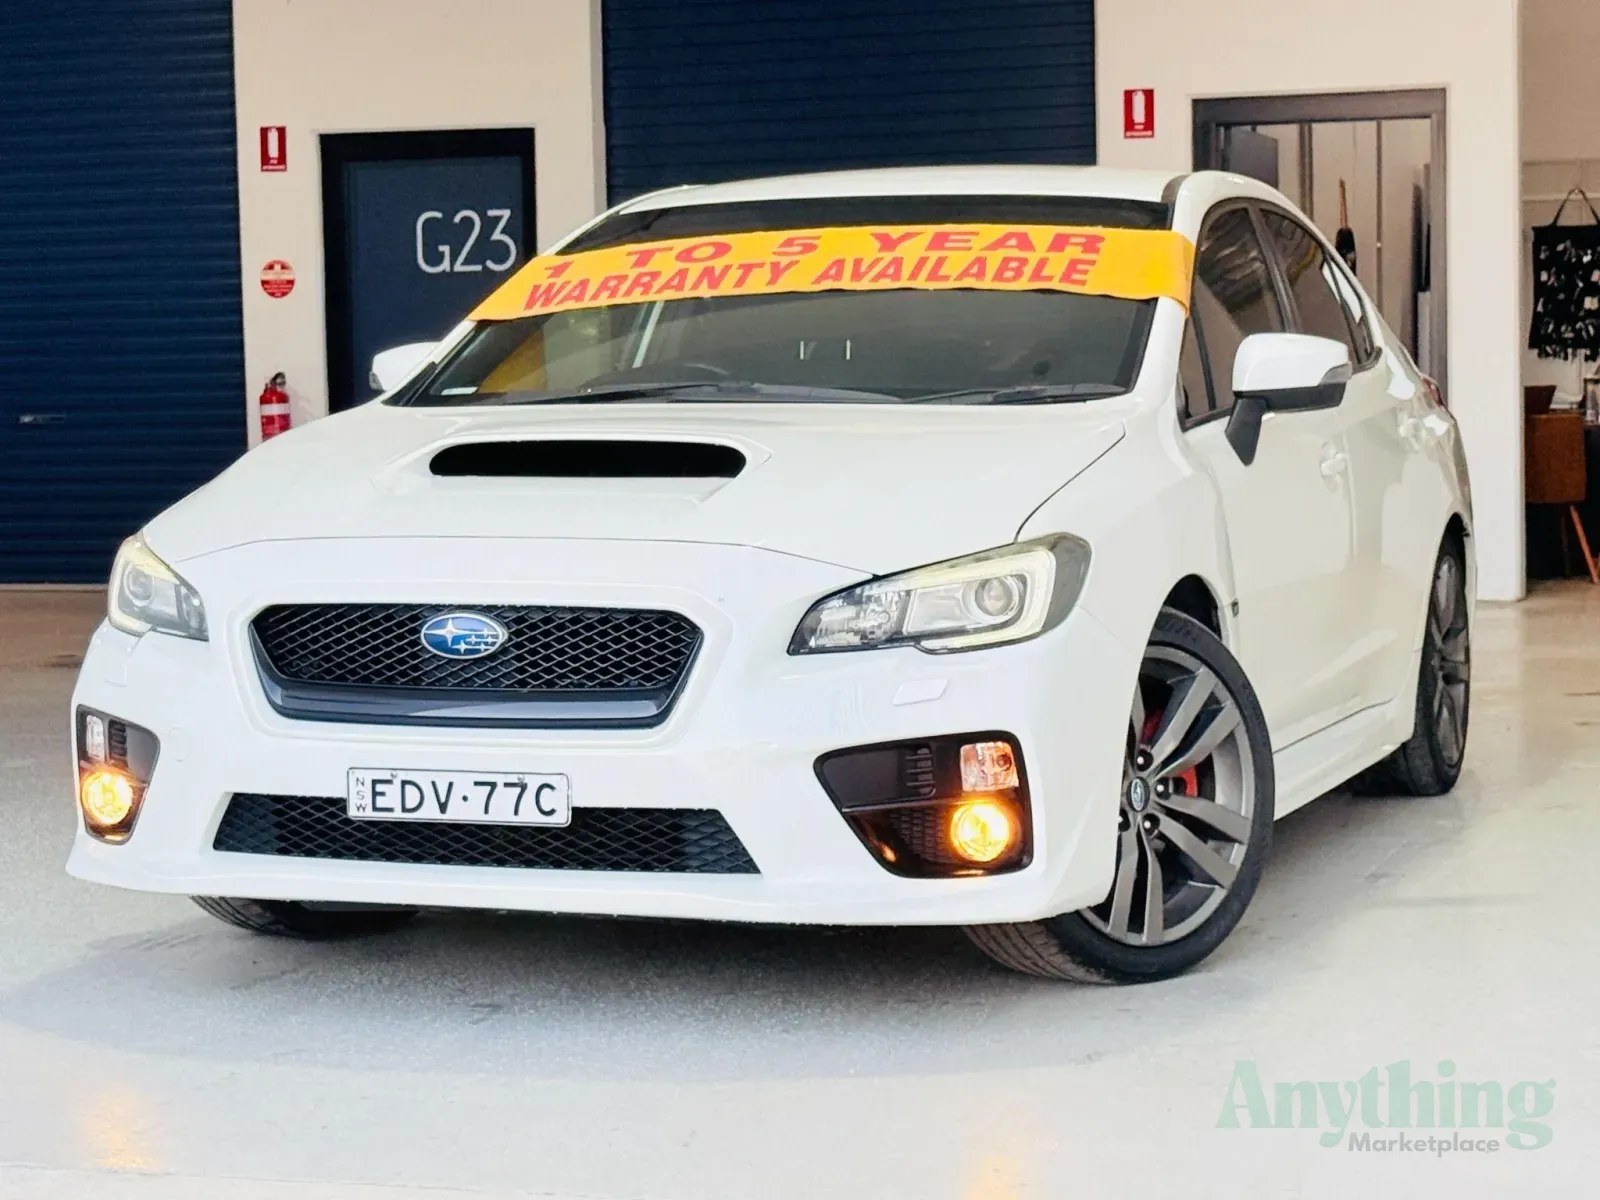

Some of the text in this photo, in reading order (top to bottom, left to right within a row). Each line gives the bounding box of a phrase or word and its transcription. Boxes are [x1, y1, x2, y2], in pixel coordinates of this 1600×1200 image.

[416, 209, 517, 273] G23
[544, 231, 1106, 279] 1 TO 5 YEAR
[523, 256, 1096, 311] WARRANTY AVAILABLE
